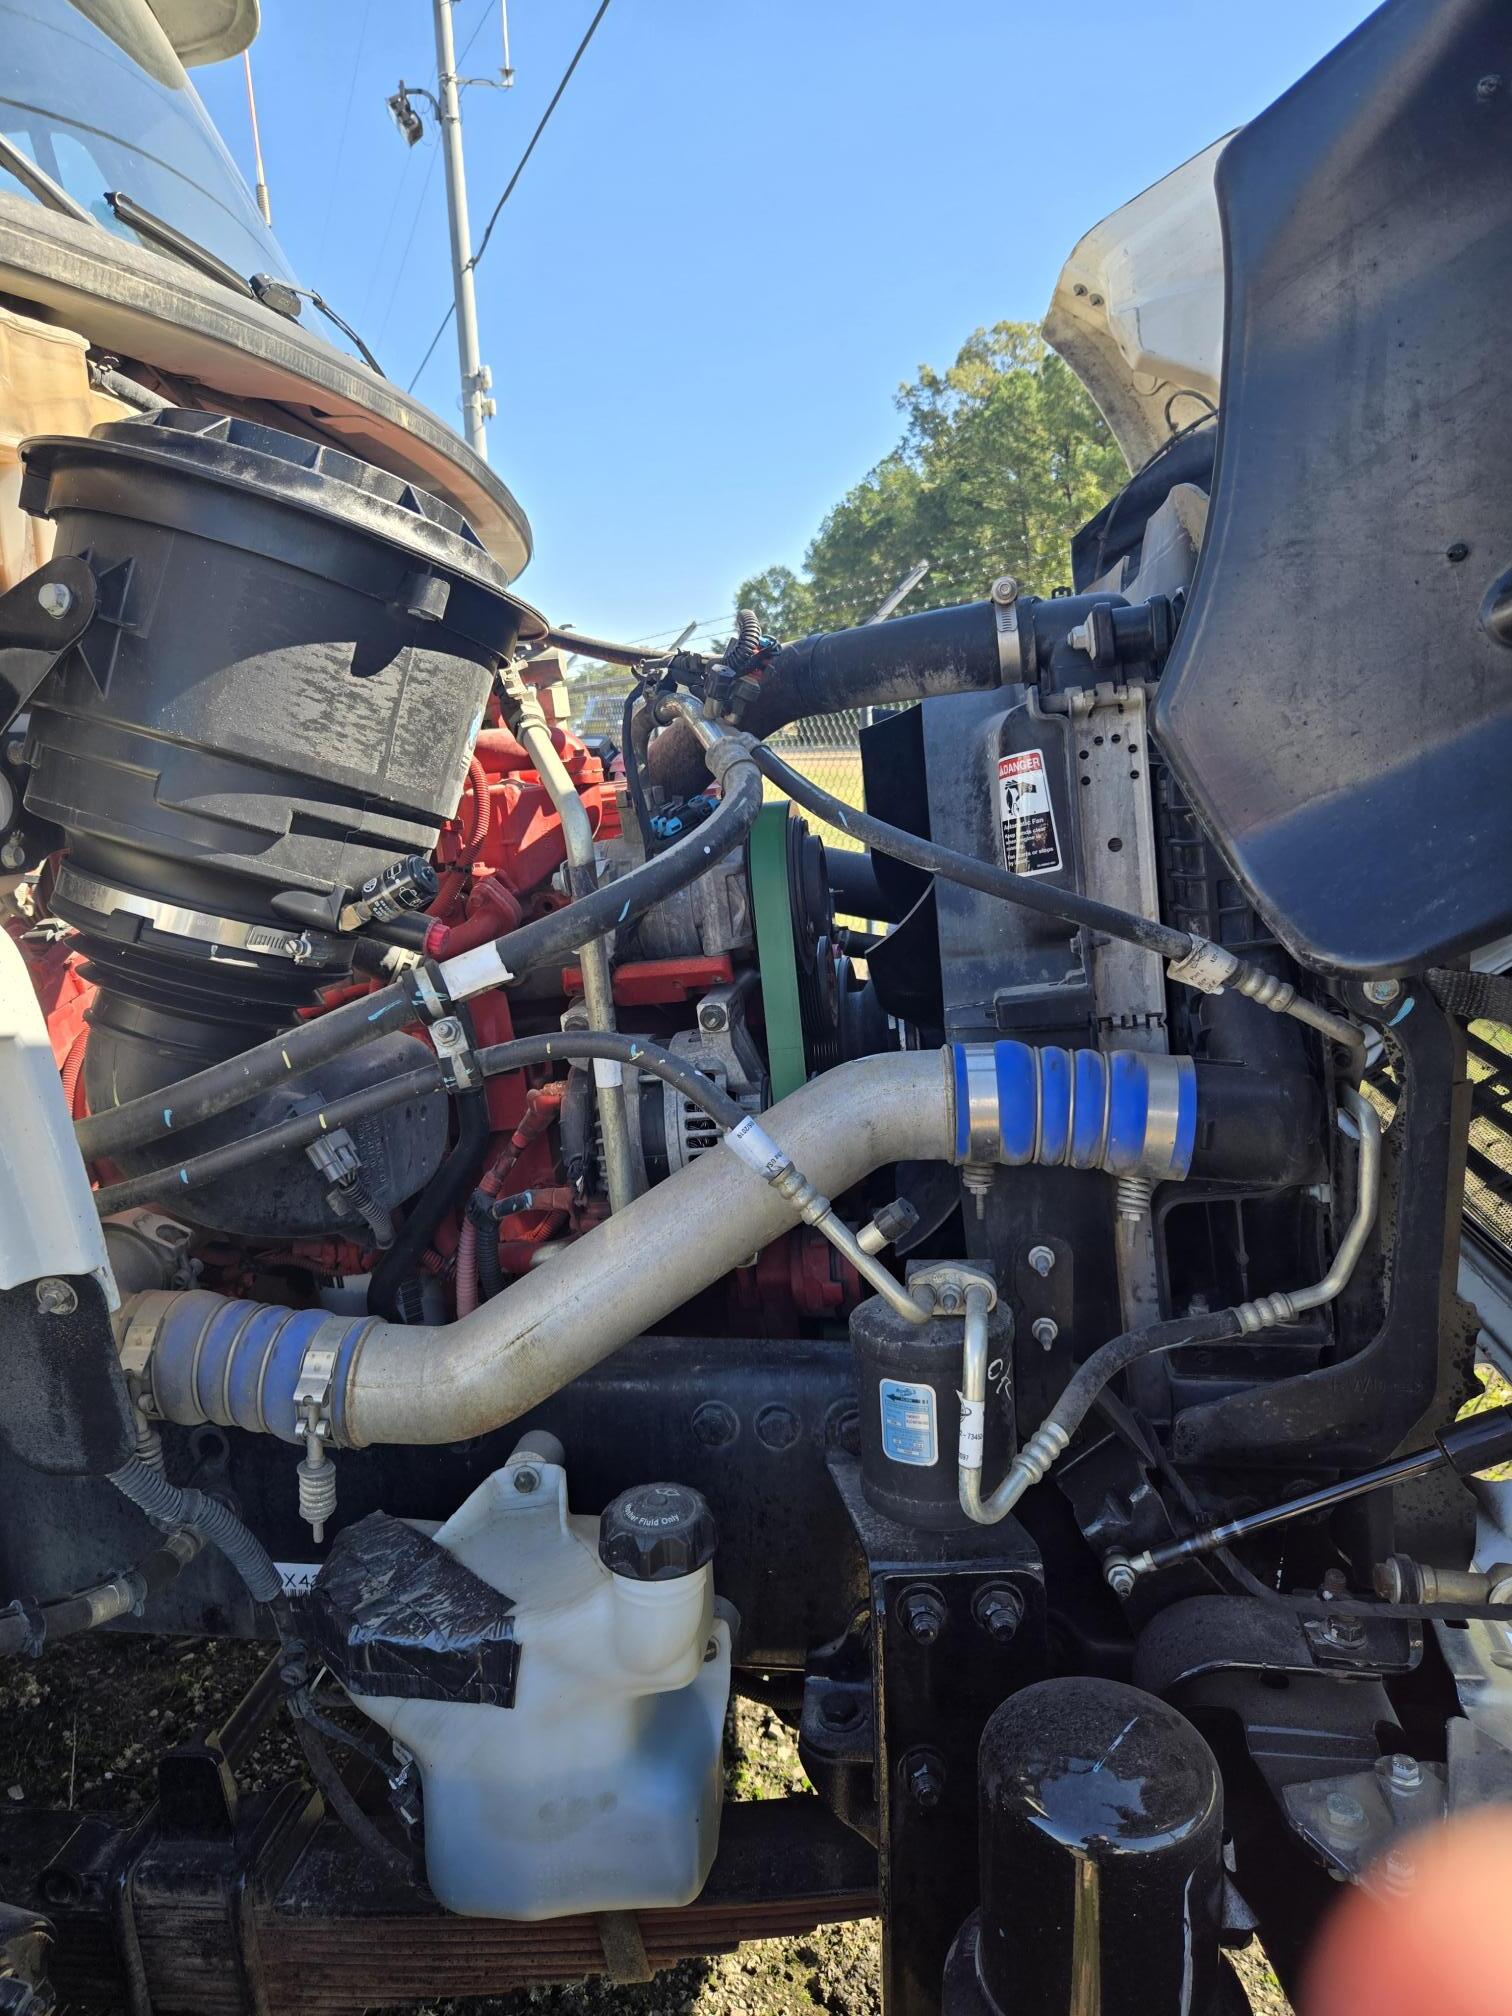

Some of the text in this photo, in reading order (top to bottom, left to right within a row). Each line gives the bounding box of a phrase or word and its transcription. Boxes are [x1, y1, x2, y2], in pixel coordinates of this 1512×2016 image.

[1003, 758, 1040, 775] DANGER
[1032, 817, 1044, 825] Fan
[638, 1517, 659, 1526] Fluid
[661, 1513, 680, 1525] Only
